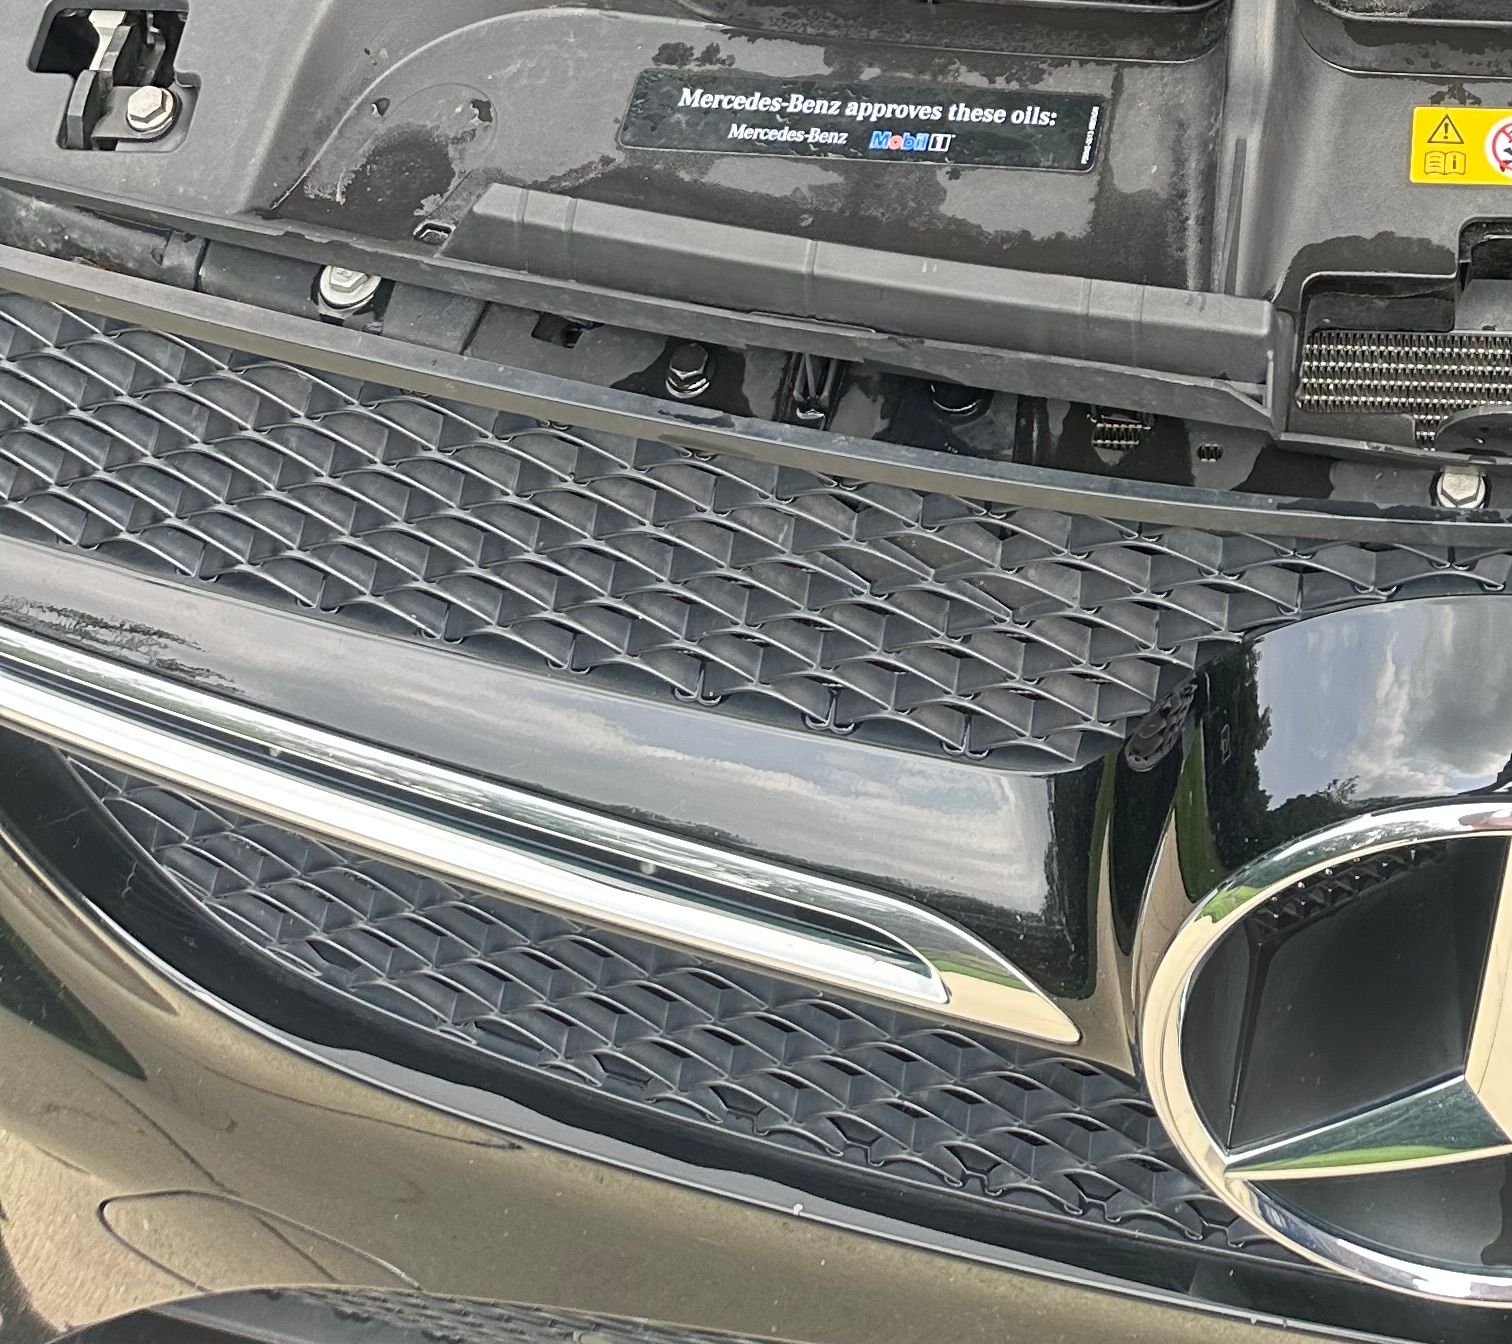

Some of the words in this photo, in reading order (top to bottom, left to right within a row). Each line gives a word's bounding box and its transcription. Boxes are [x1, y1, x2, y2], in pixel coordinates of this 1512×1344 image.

[678, 88, 841, 117] Mercedes-Benz
[845, 100, 943, 124] approves
[948, 103, 1006, 123] these
[1010, 106, 1058, 126] oils:
[728, 124, 849, 145] Mercedes-Benz
[869, 130, 929, 151] Mobil
